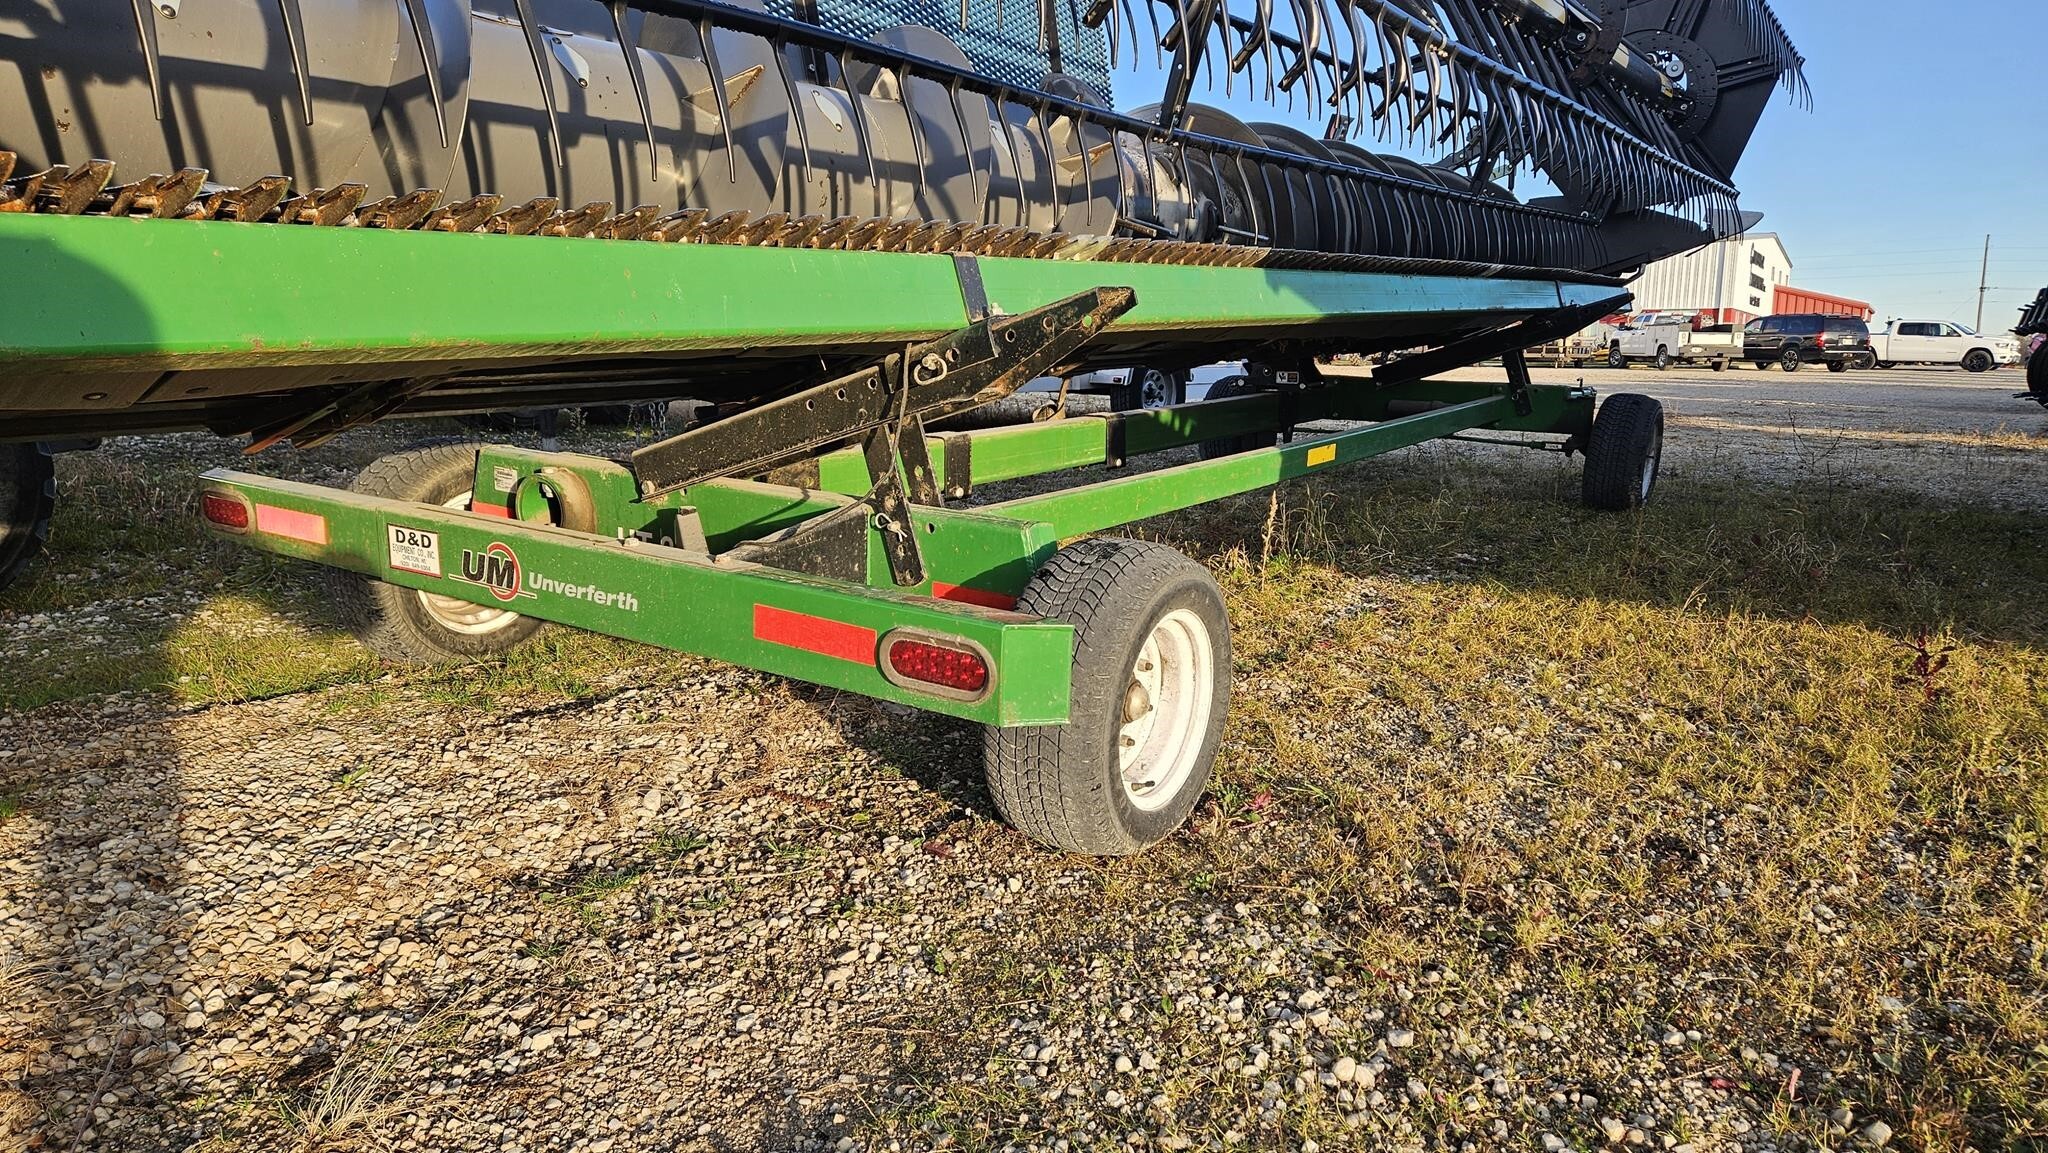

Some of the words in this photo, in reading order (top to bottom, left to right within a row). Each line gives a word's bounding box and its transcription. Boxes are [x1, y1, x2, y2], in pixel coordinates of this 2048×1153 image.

[395, 529, 431, 549] D&D
[462, 550, 515, 590] UM
[528, 572, 639, 611] Unverferth
